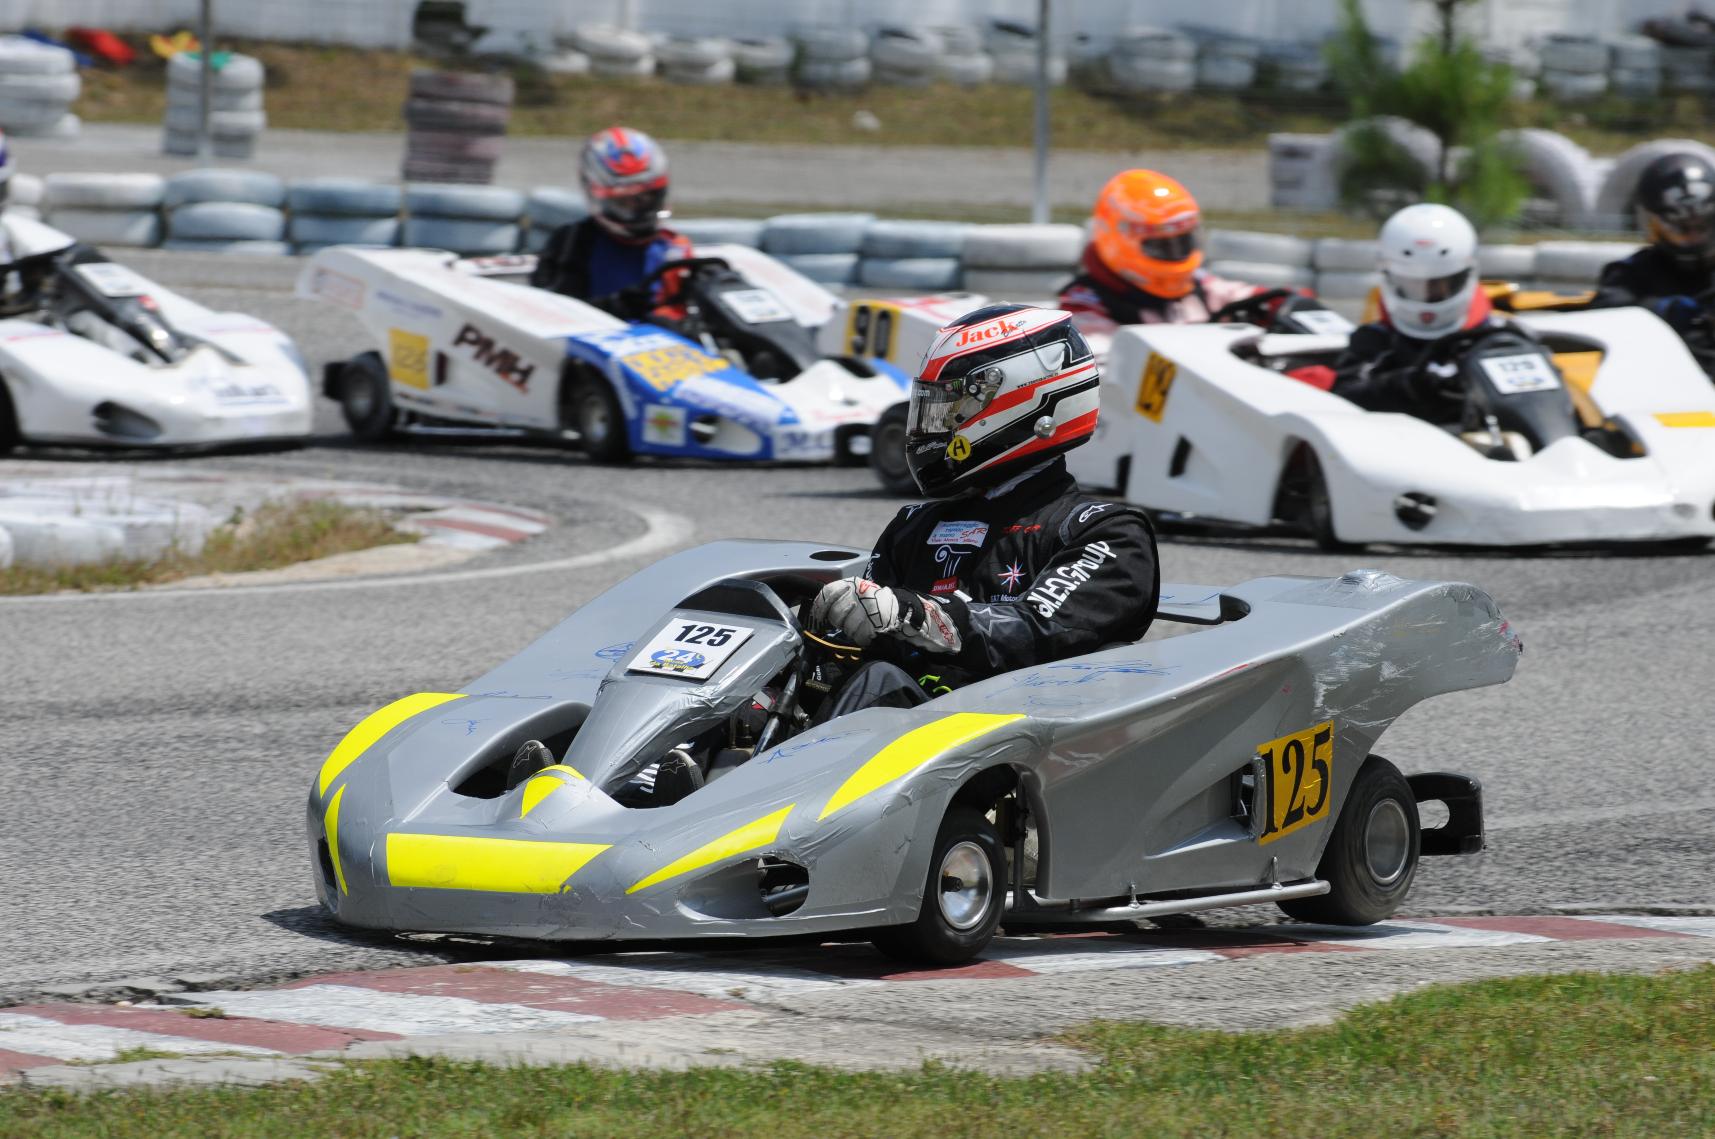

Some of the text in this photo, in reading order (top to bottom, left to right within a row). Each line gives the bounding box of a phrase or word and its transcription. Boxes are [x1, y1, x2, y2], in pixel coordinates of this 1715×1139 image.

[956, 321, 1019, 347] Jack
[953, 439, 967, 456] H
[673, 624, 737, 647] 125
[1261, 727, 1331, 838] 125
